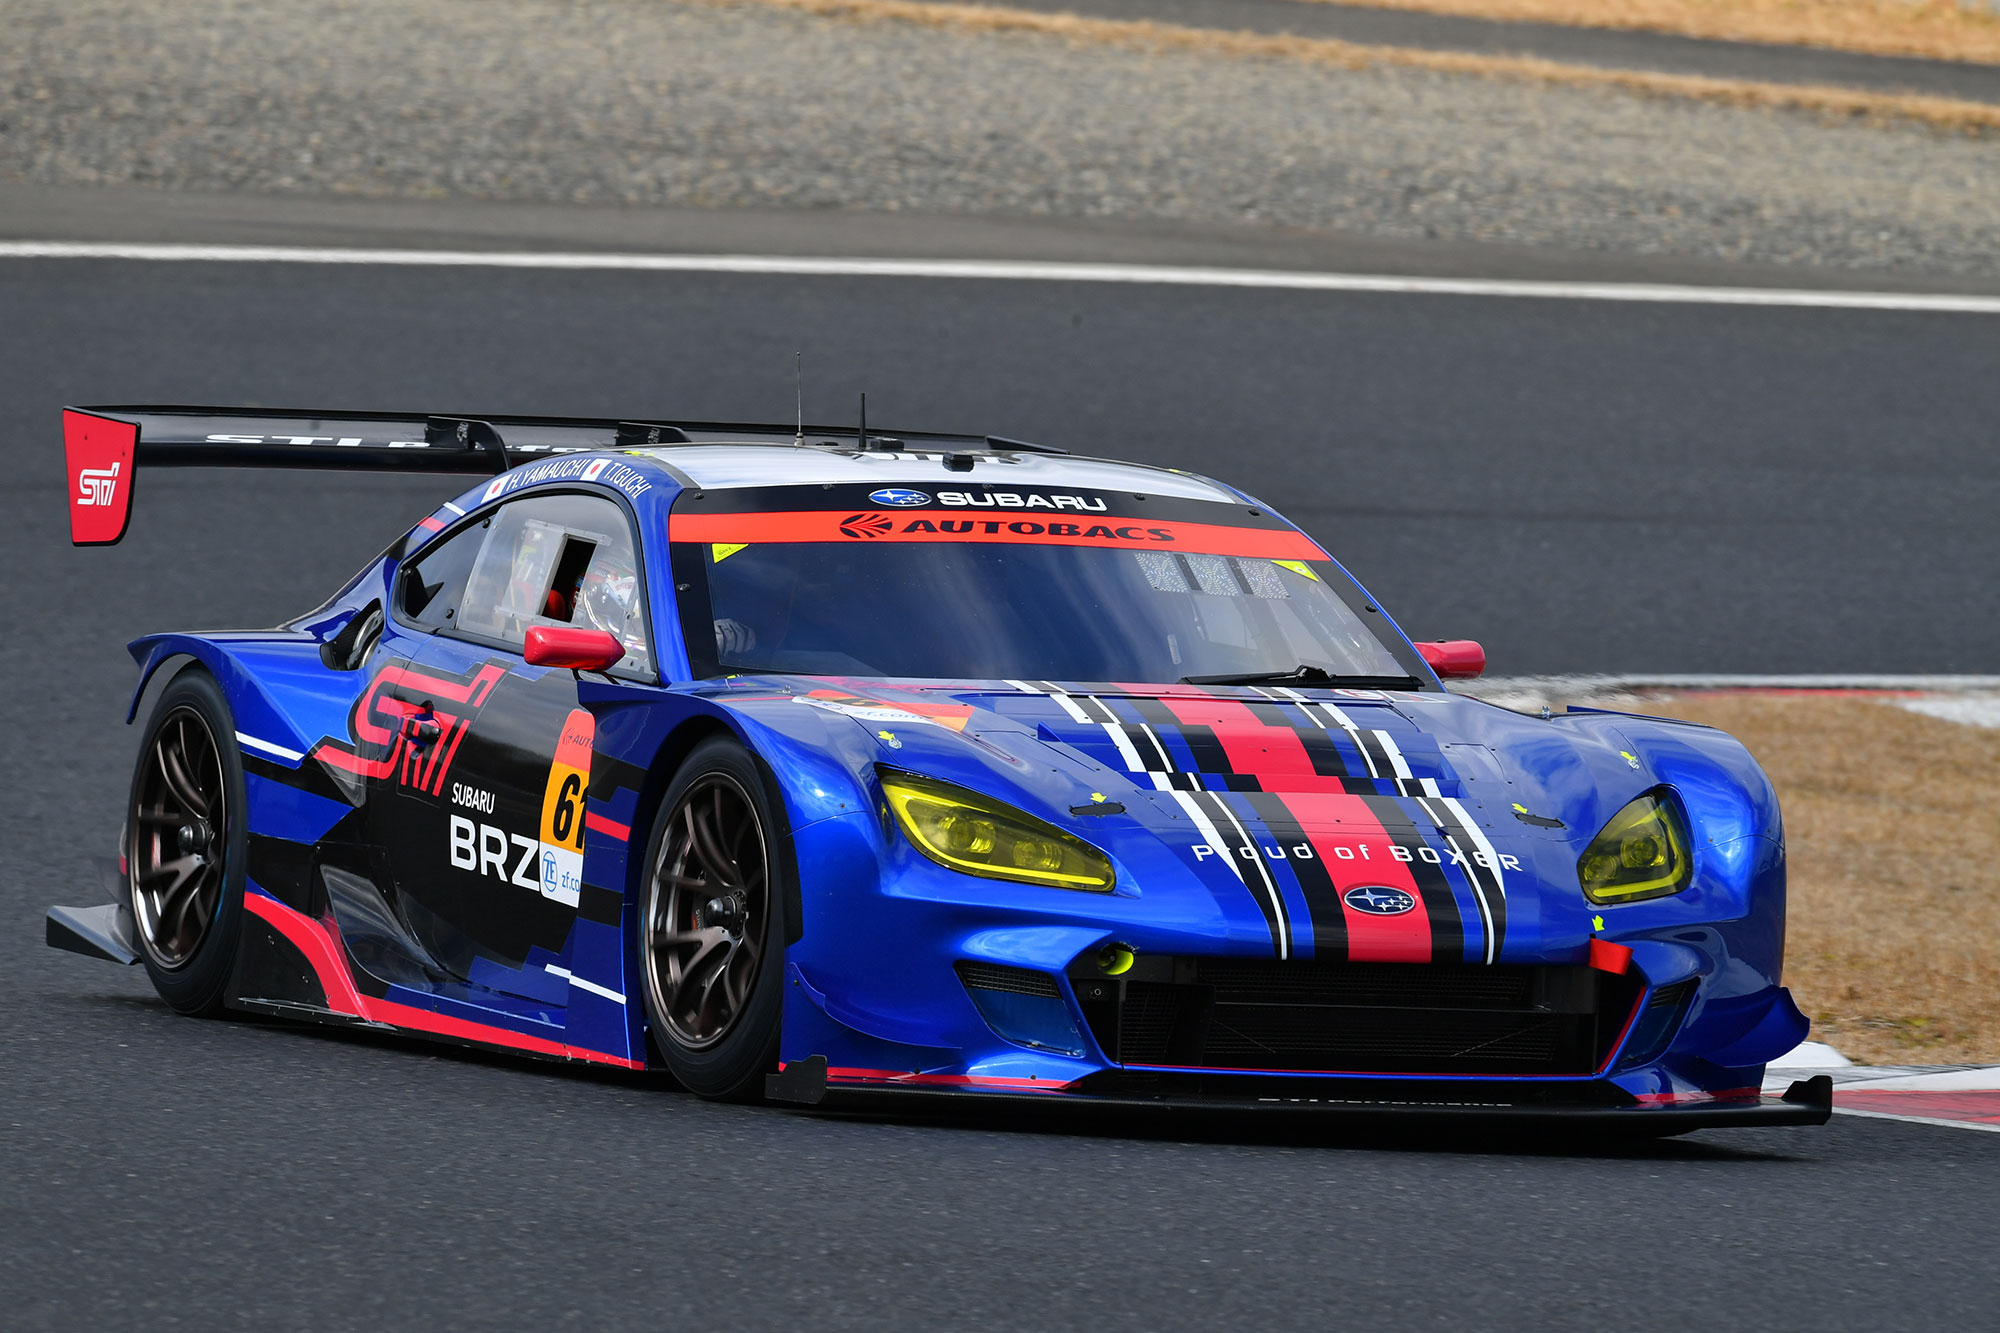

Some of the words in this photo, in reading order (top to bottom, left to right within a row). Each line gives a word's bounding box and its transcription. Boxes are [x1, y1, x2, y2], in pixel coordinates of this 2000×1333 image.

[936, 491, 1107, 512] SUBARU
[900, 519, 1176, 542] AUTOBACS
[452, 782, 495, 814] SUBARU
[451, 814, 540, 892] BRZ
[1191, 843, 1313, 862] Poud
[1333, 844, 1370, 860] of
